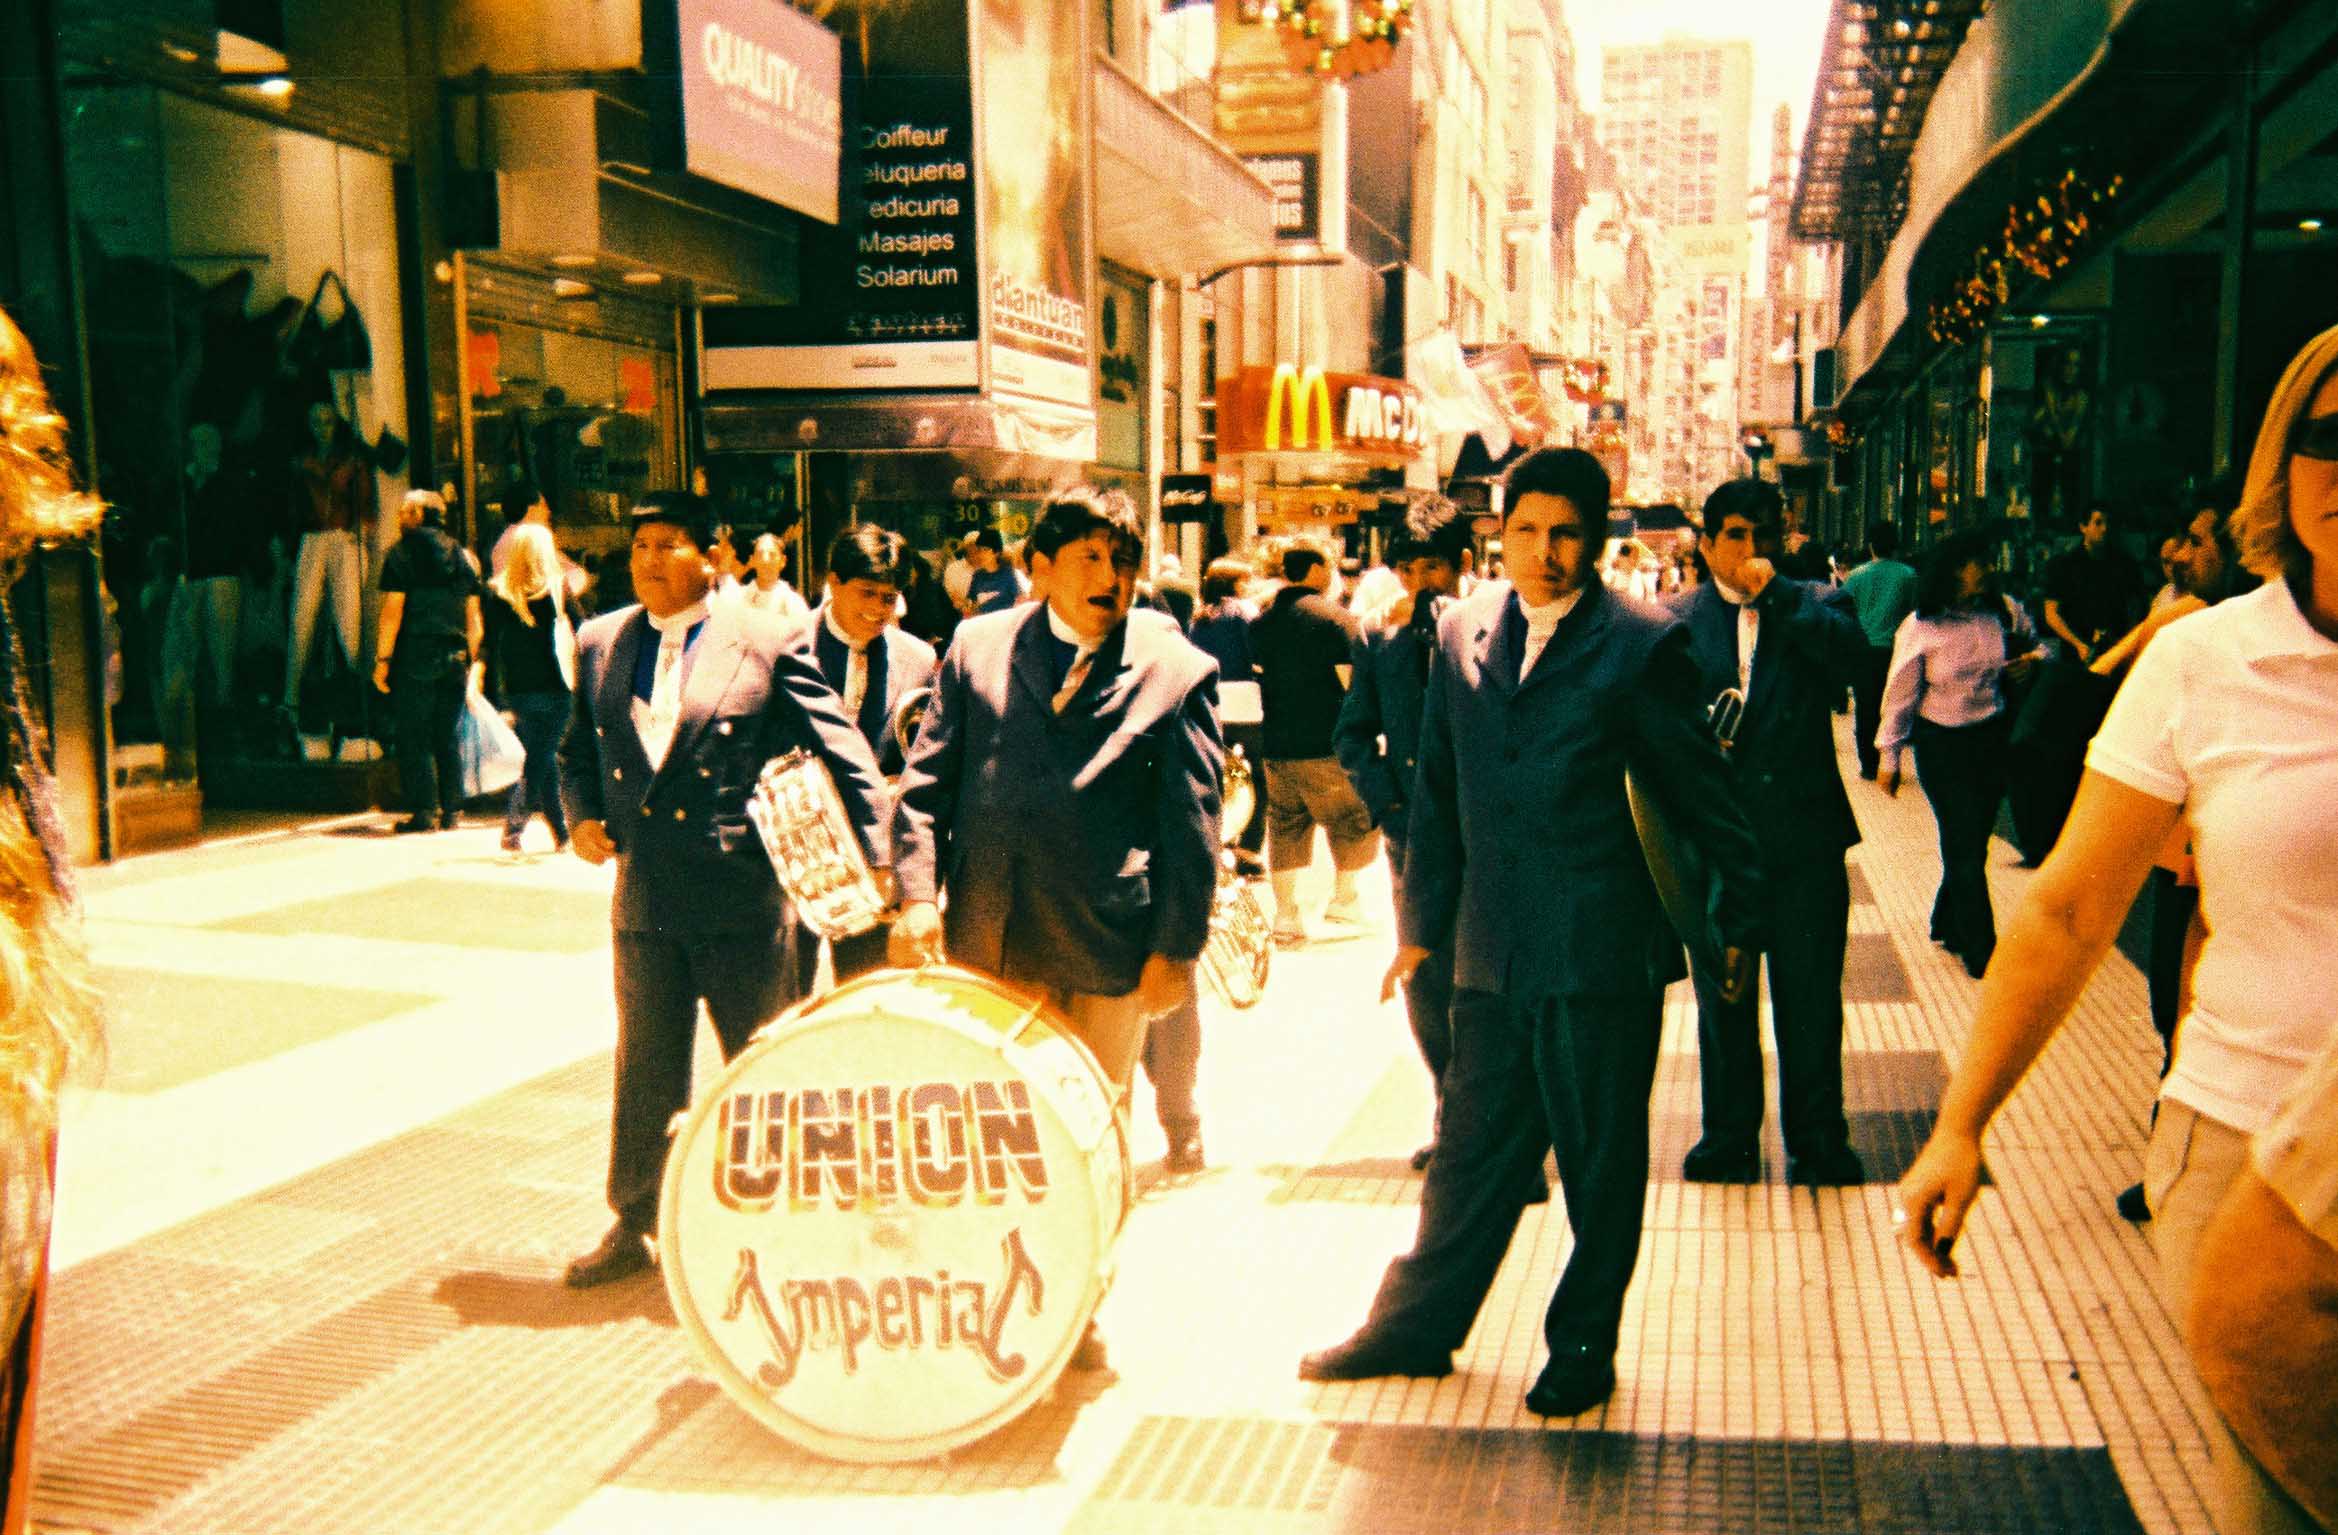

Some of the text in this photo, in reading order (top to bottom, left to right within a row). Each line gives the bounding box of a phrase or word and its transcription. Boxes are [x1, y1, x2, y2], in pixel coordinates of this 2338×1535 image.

[704, 22, 799, 112] QUALITY
[862, 158, 966, 187] eluqueria
[866, 193, 960, 218] edicuria
[859, 229, 955, 256] Masajes
[857, 264, 959, 288] Solarium
[713, 1080, 1050, 1213] UNION
